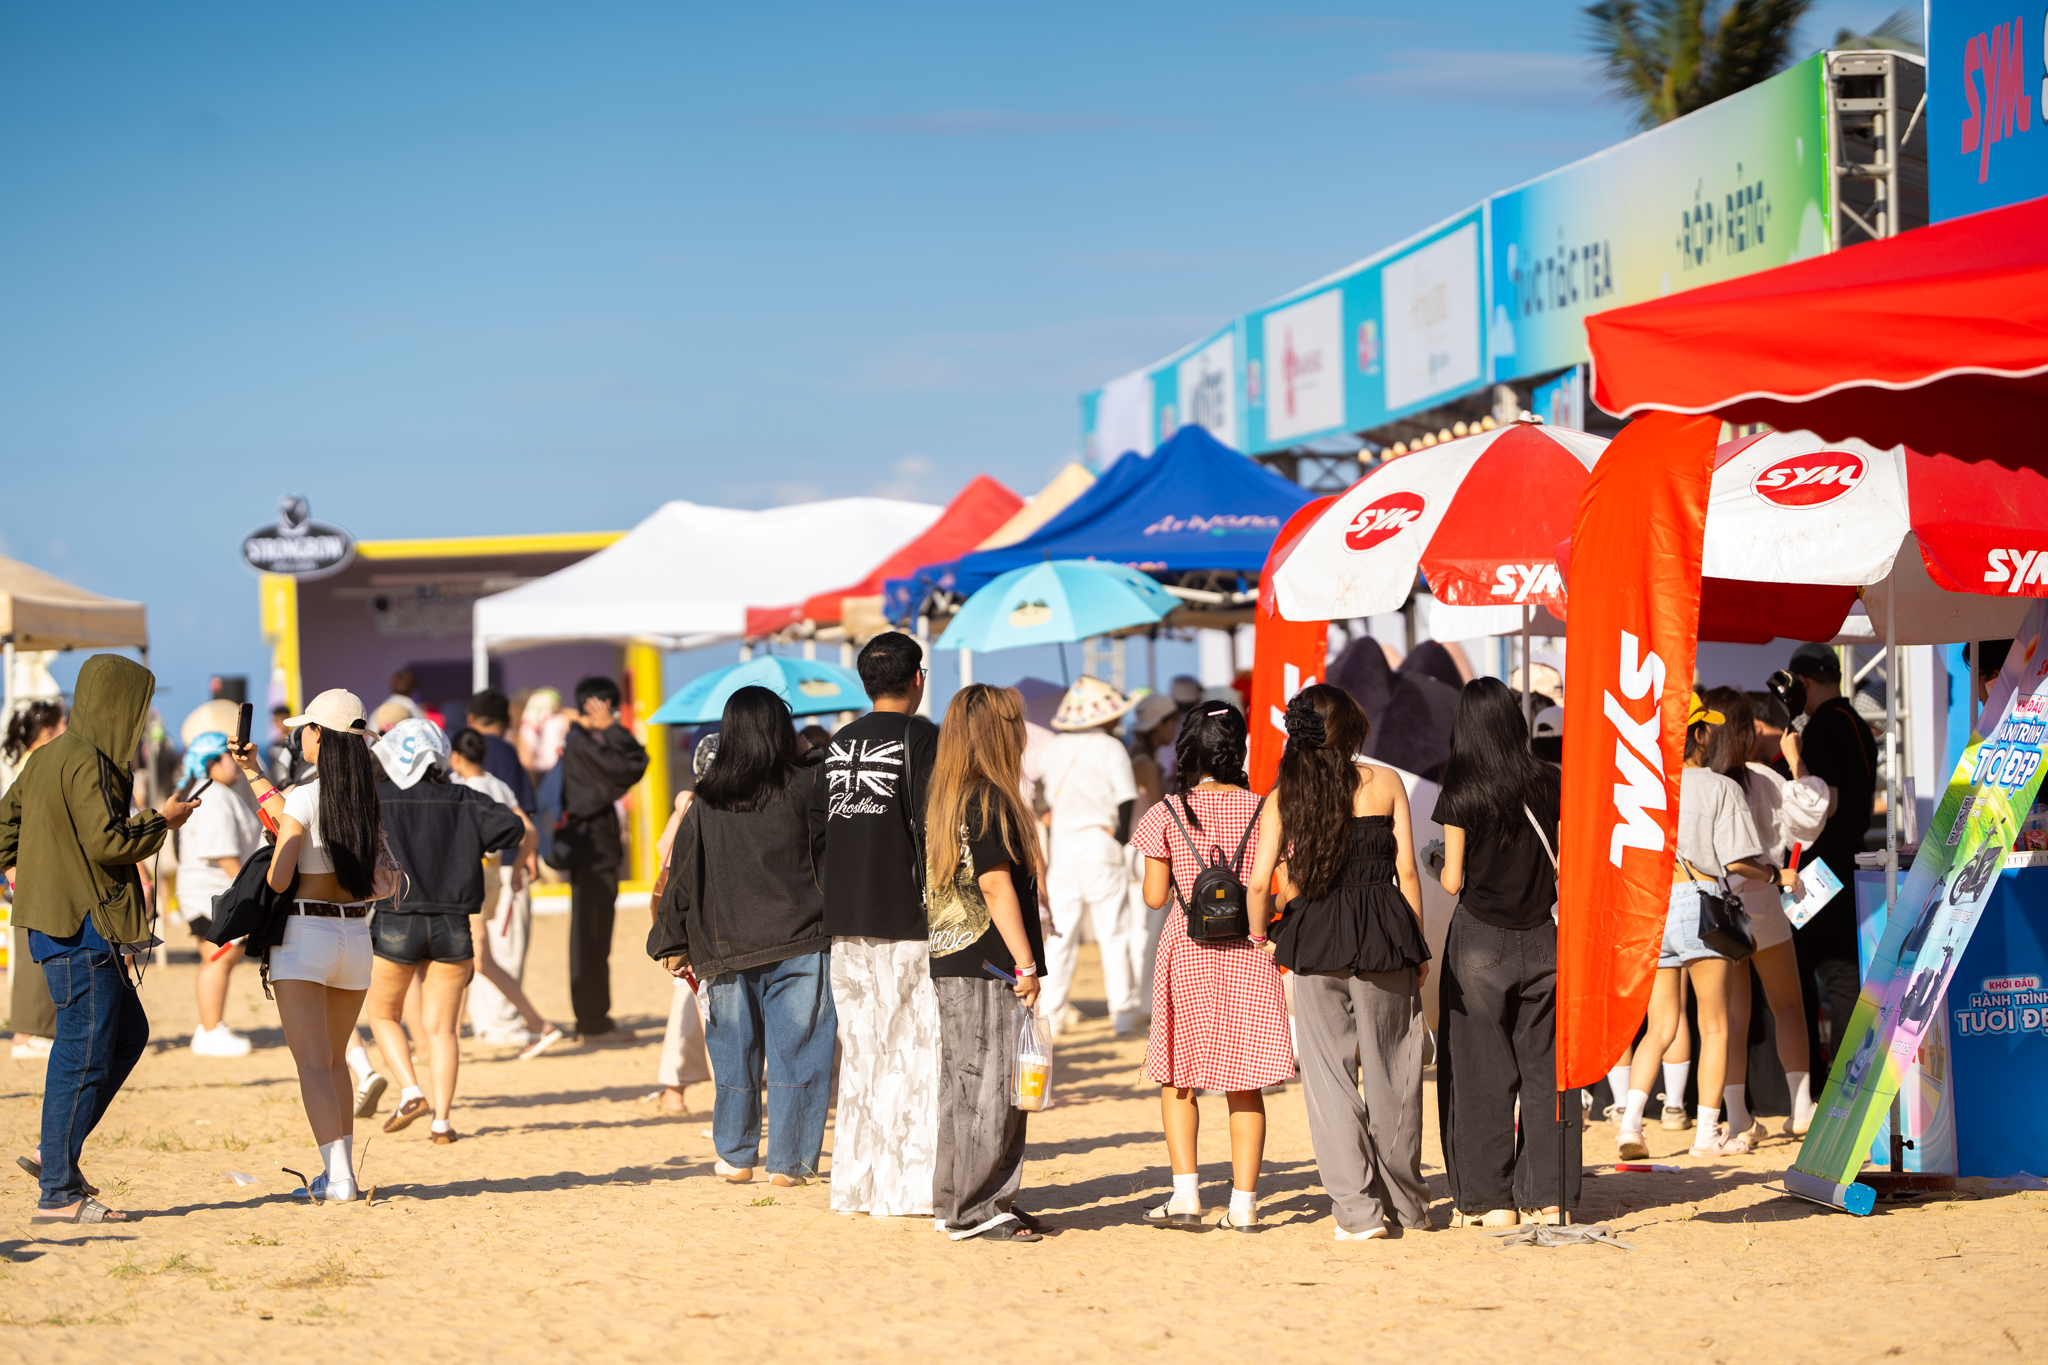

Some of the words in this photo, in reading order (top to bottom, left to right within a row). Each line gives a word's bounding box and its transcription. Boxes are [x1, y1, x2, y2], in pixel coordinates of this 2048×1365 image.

[1960, 16, 2031, 184] SYM
[1755, 465, 1858, 493] SYM
[1347, 508, 1420, 538] SYM
[1490, 564, 1566, 602] SYM
[399, 736, 415, 764] S
[1604, 630, 1668, 868] SYM
[2001, 750, 2040, 795] ĐẸP
[1972, 993, 2011, 1008] HÀNH
[1957, 1007, 2015, 1033] TƯƠI
